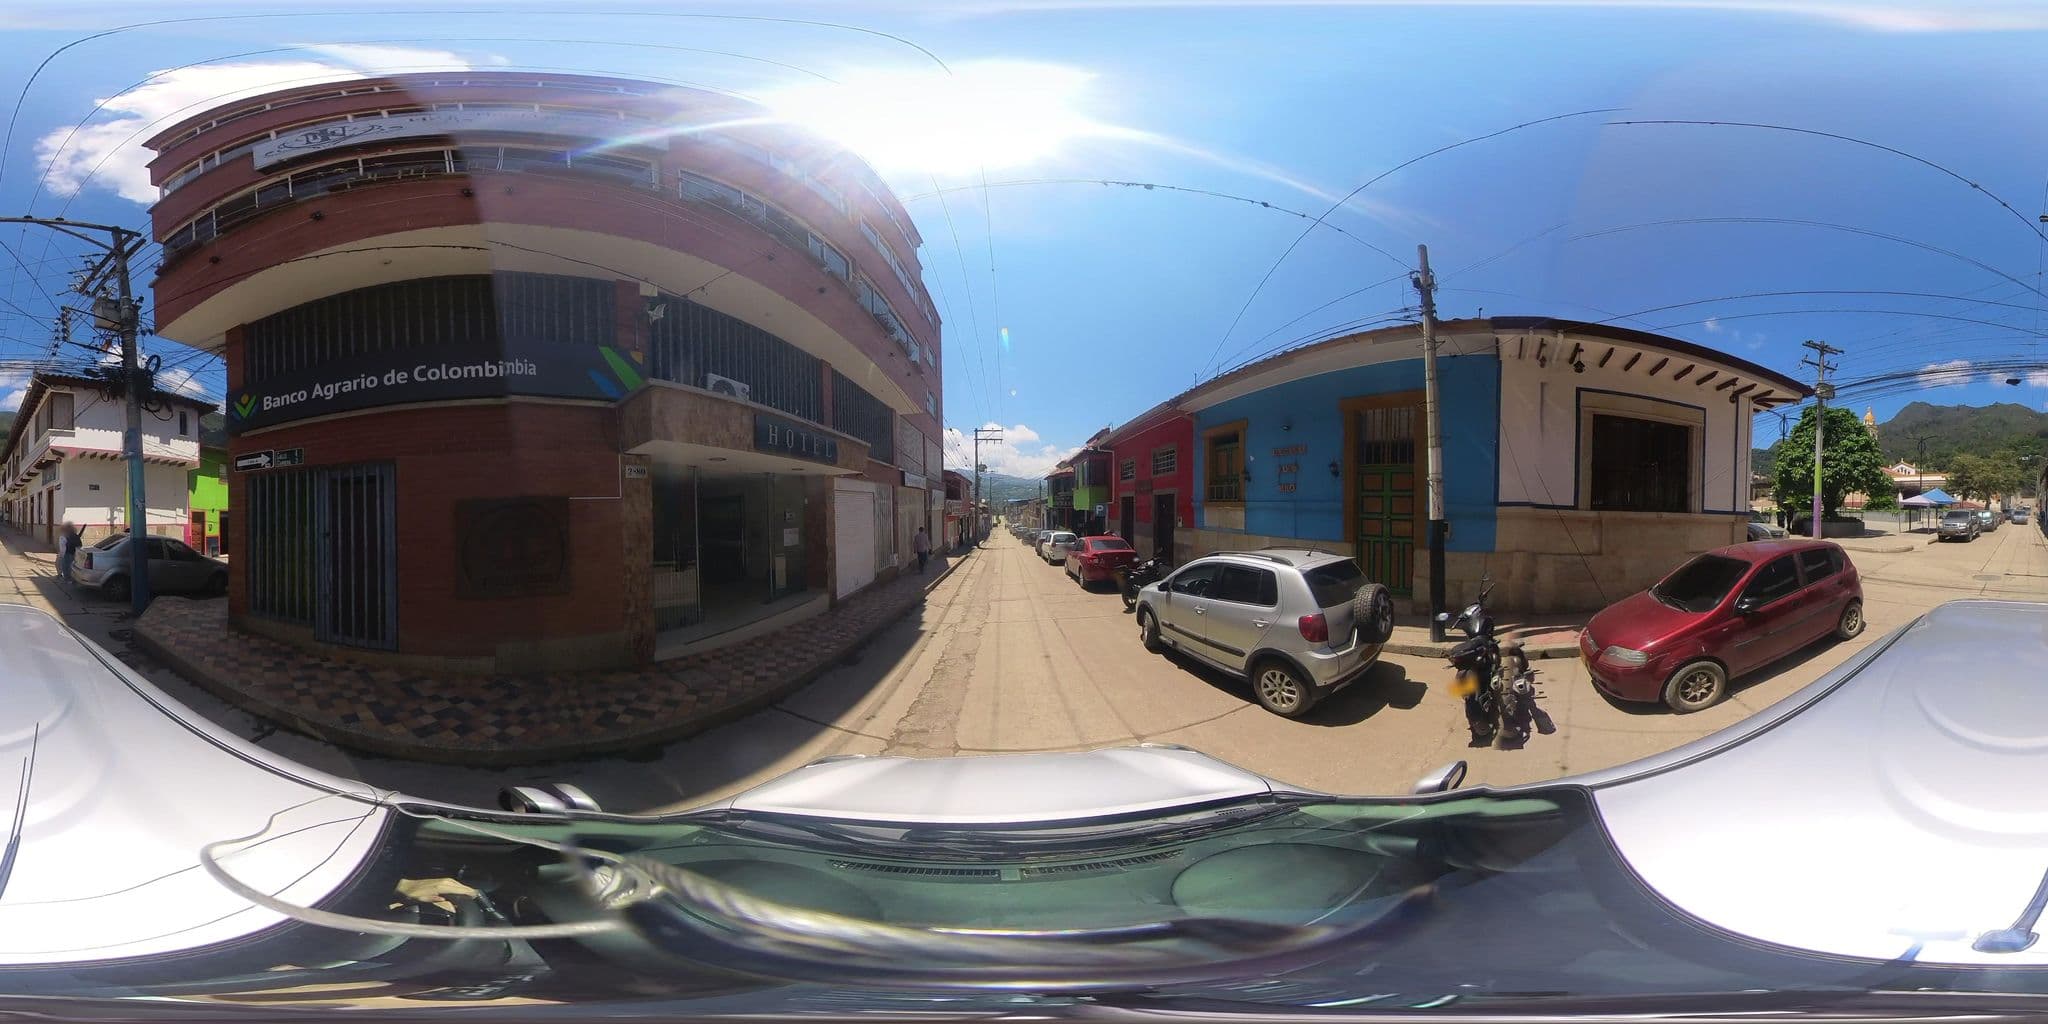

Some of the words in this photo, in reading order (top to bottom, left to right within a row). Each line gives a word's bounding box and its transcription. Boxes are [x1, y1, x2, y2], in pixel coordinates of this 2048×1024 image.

[263, 388, 307, 411] Banco
[311, 373, 378, 400] Agrario
[383, 369, 408, 387] de
[768, 424, 832, 458] HOTEL
[1096, 504, 1104, 515] P
